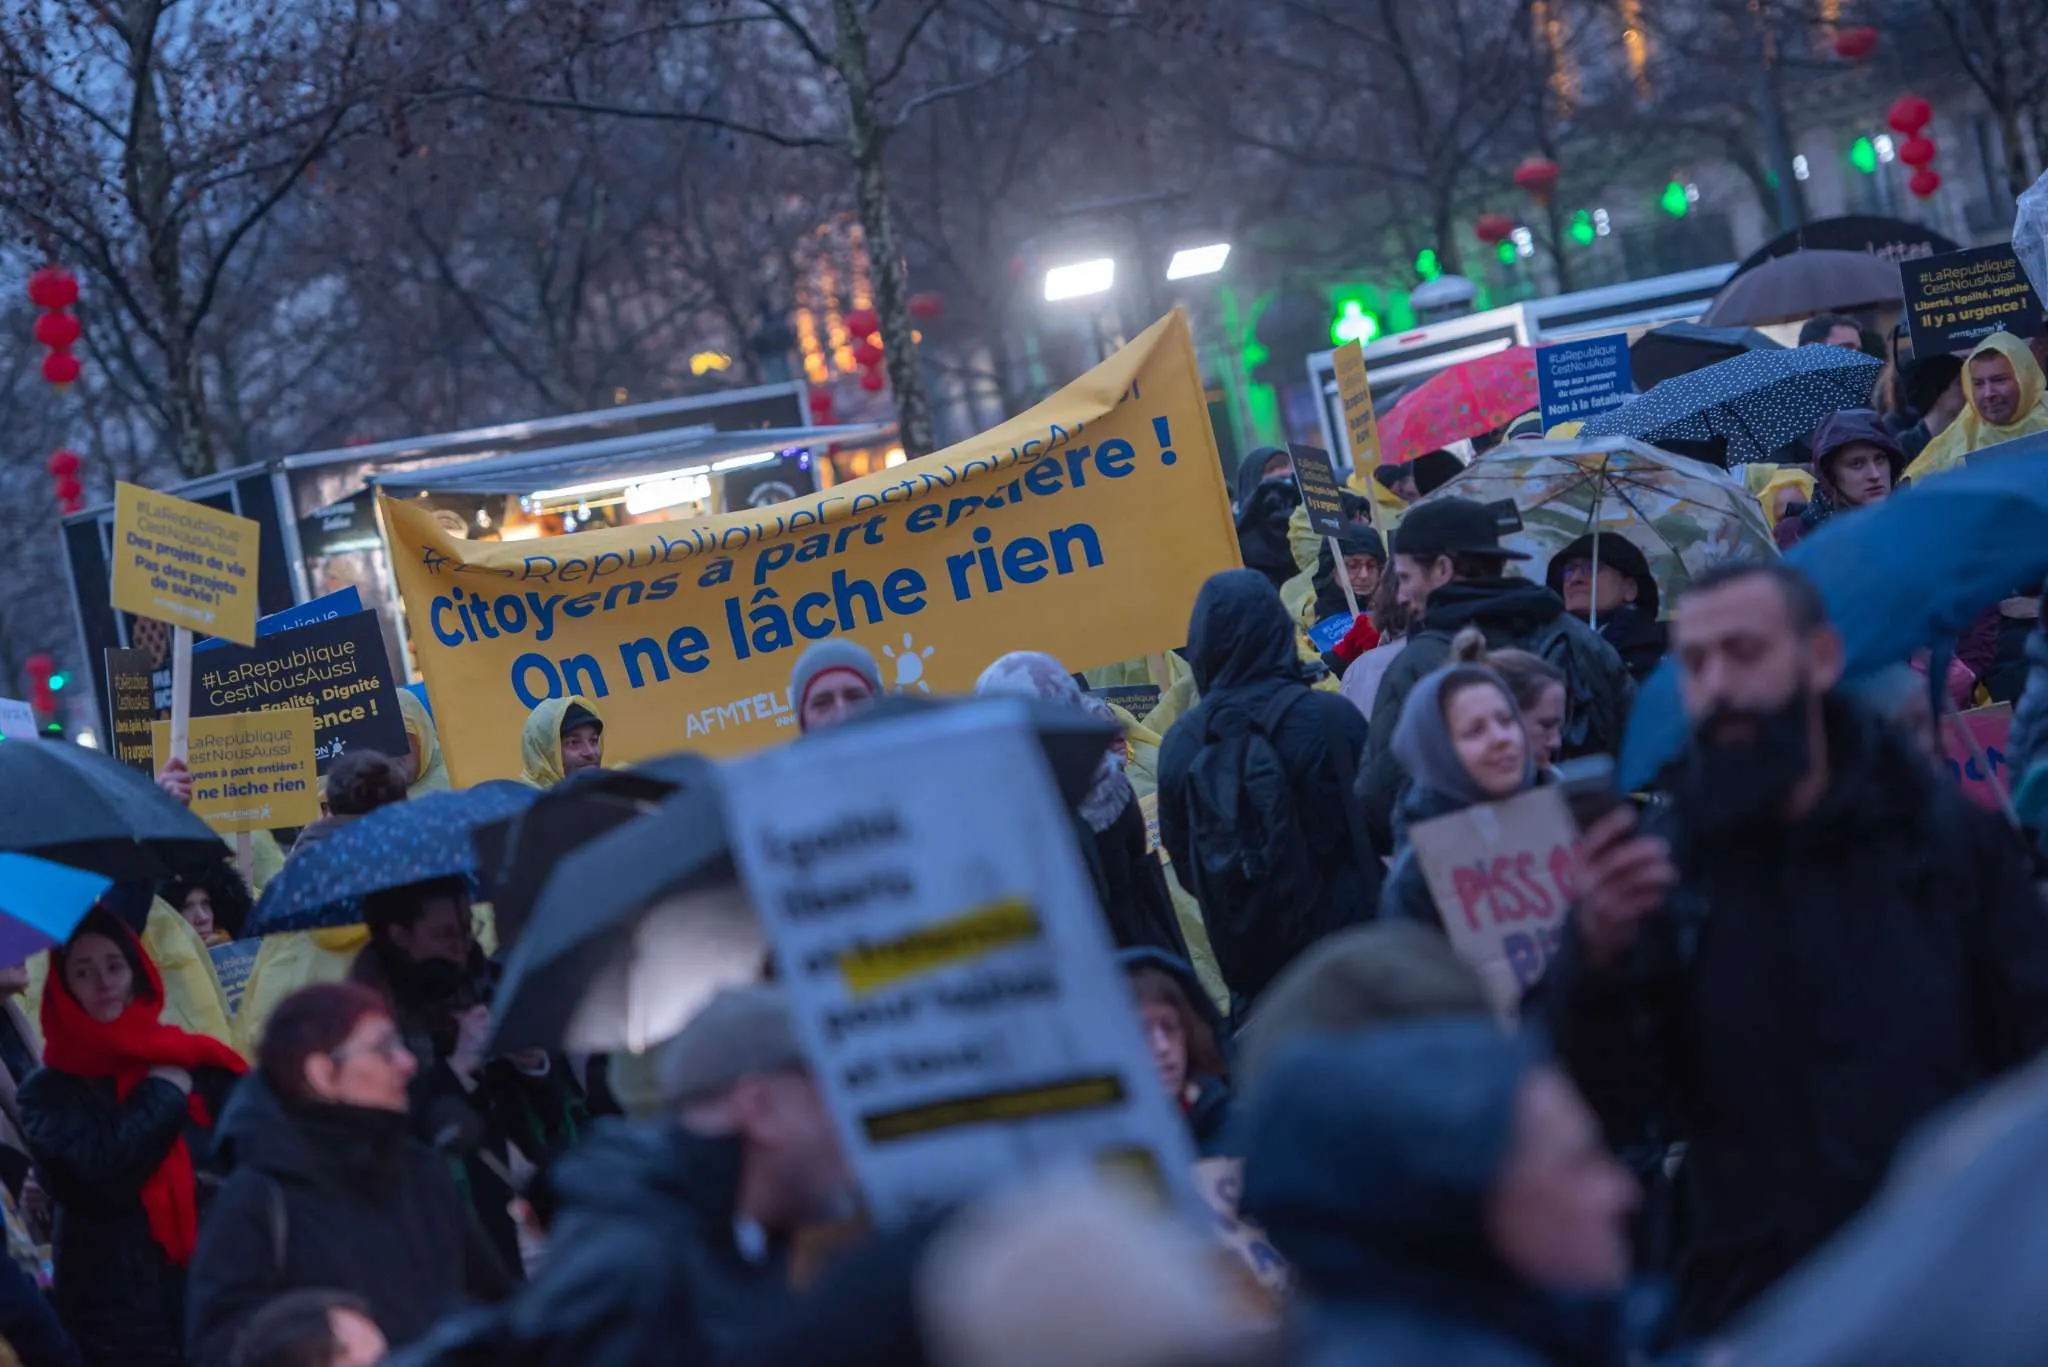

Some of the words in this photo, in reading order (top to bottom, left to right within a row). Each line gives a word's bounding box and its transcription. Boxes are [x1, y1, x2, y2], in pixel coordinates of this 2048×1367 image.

[1920, 258, 2016, 284] #LaRepublique
[1923, 270, 2016, 296] CestNousAussi
[1914, 296, 1953, 312] Liberté,
[1993, 283, 2030, 298] Dignité
[1921, 314, 1932, 328] Il
[1935, 313, 1945, 329] y
[1947, 311, 1957, 323] a
[1960, 300, 2019, 320] urgence
[1548, 405, 1570, 416] Non
[1571, 400, 1578, 411] à
[1580, 399, 1590, 410] la
[136, 501, 241, 541] #LaRepublique
[430, 573, 682, 648] Citoyens
[698, 556, 734, 588] à
[753, 513, 887, 587] part
[1152, 415, 1177, 466] !
[127, 532, 153, 550] Des
[156, 541, 204, 565] projets
[207, 555, 224, 571] de
[227, 560, 247, 578] vie
[134, 555, 160, 573] Pas
[163, 564, 187, 580] des
[190, 572, 238, 595] projets
[151, 576, 169, 590] de
[172, 582, 213, 603] survie
[511, 652, 609, 711] On
[619, 626, 710, 690] ne
[725, 567, 927, 661] lâche
[946, 521, 1104, 601] rien
[202, 640, 356, 691] #LaRepublique
[209, 656, 358, 708] CestNousAussi
[322, 675, 381, 703] Dignité
[313, 705, 366, 731] ence
[369, 698, 379, 716] !
[188, 728, 294, 751] LaRepublique
[189, 745, 292, 764] estNousAussi
[191, 767, 222, 782] yens
[231, 764, 254, 779] part
[257, 761, 299, 776] entière
[197, 787, 219, 800] ne
[223, 780, 269, 798] lâche
[273, 778, 306, 793] rien
